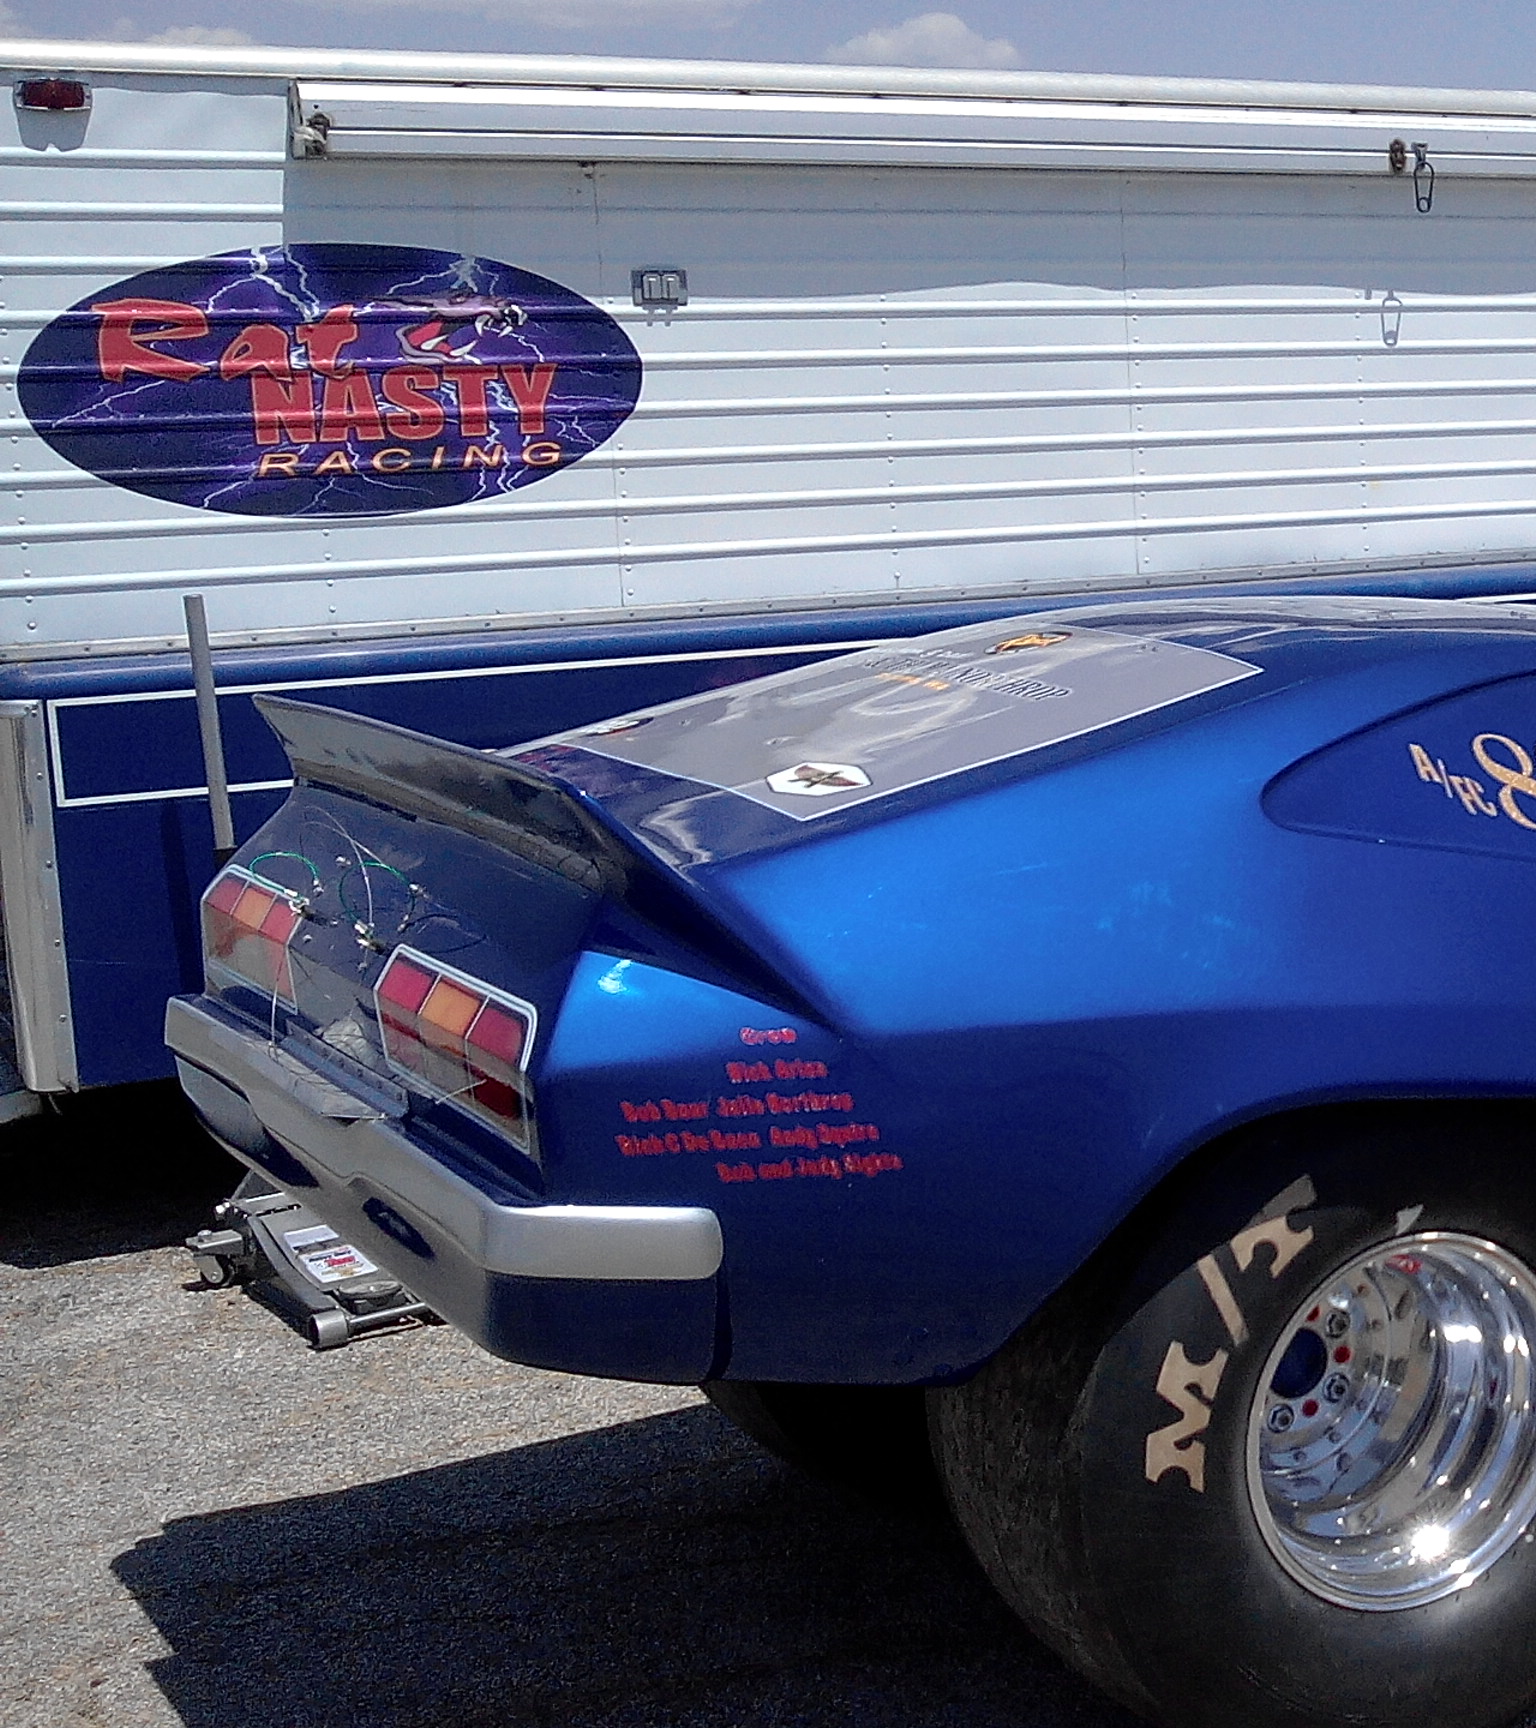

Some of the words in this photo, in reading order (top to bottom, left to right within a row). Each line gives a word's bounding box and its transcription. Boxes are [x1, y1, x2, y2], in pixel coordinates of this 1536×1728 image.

[90, 299, 358, 384] Rat
[251, 363, 559, 446] NASTY
[257, 442, 563, 478] RACING
